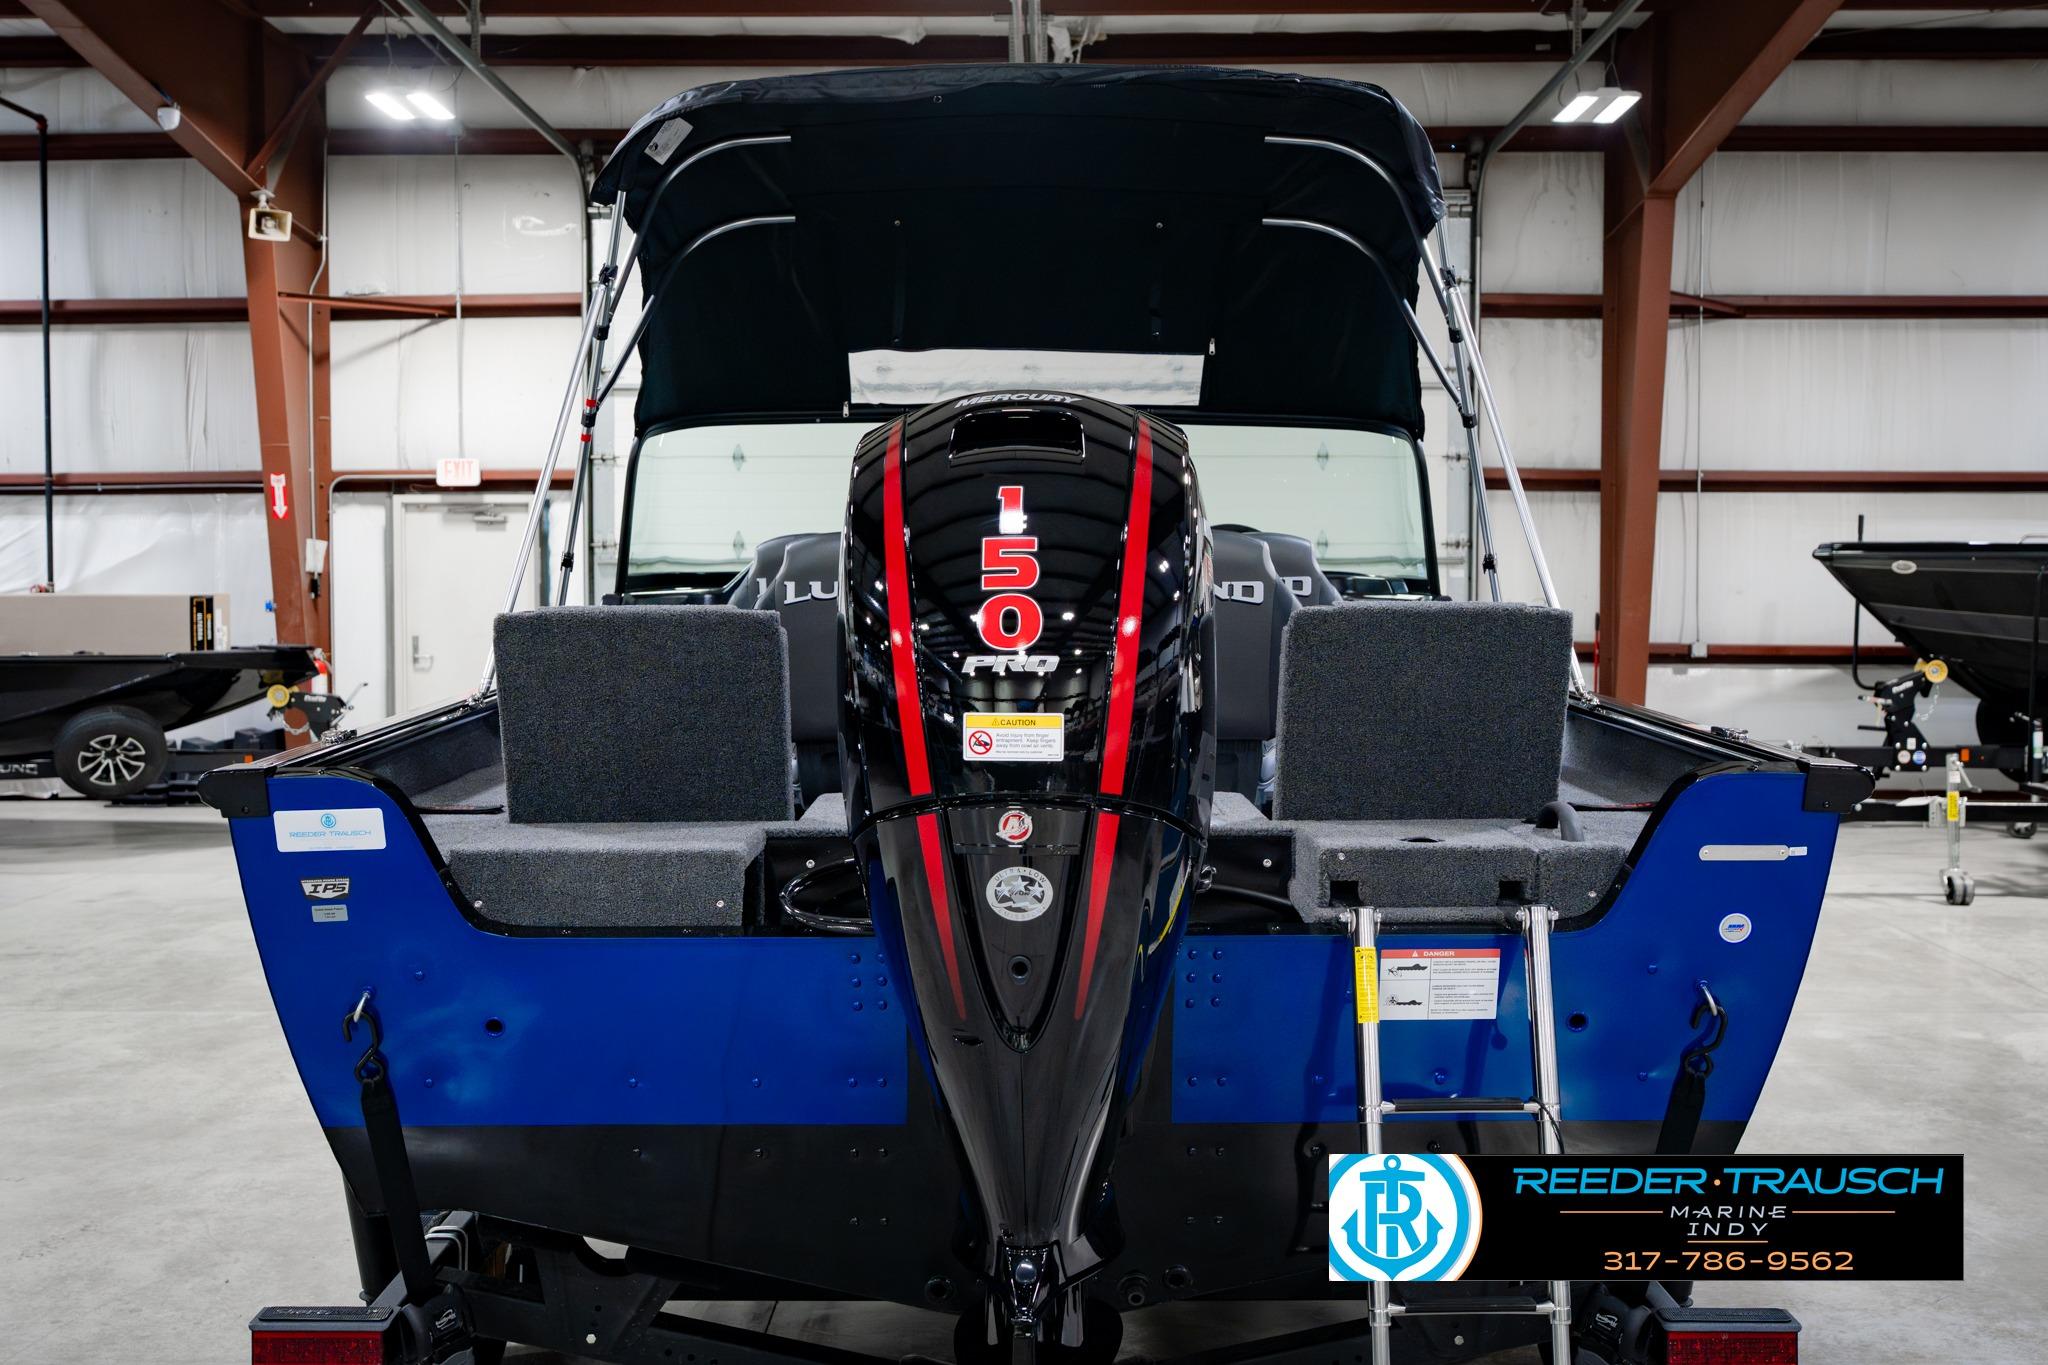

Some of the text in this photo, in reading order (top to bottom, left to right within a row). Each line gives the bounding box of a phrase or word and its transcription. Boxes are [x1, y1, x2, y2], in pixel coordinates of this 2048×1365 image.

[954, 393, 1082, 408] MERCURY
[444, 461, 473, 480] EXIT
[961, 655, 1060, 673] PRO
[1028, 869, 1046, 883] LOW
[309, 882, 347, 893] IPS
